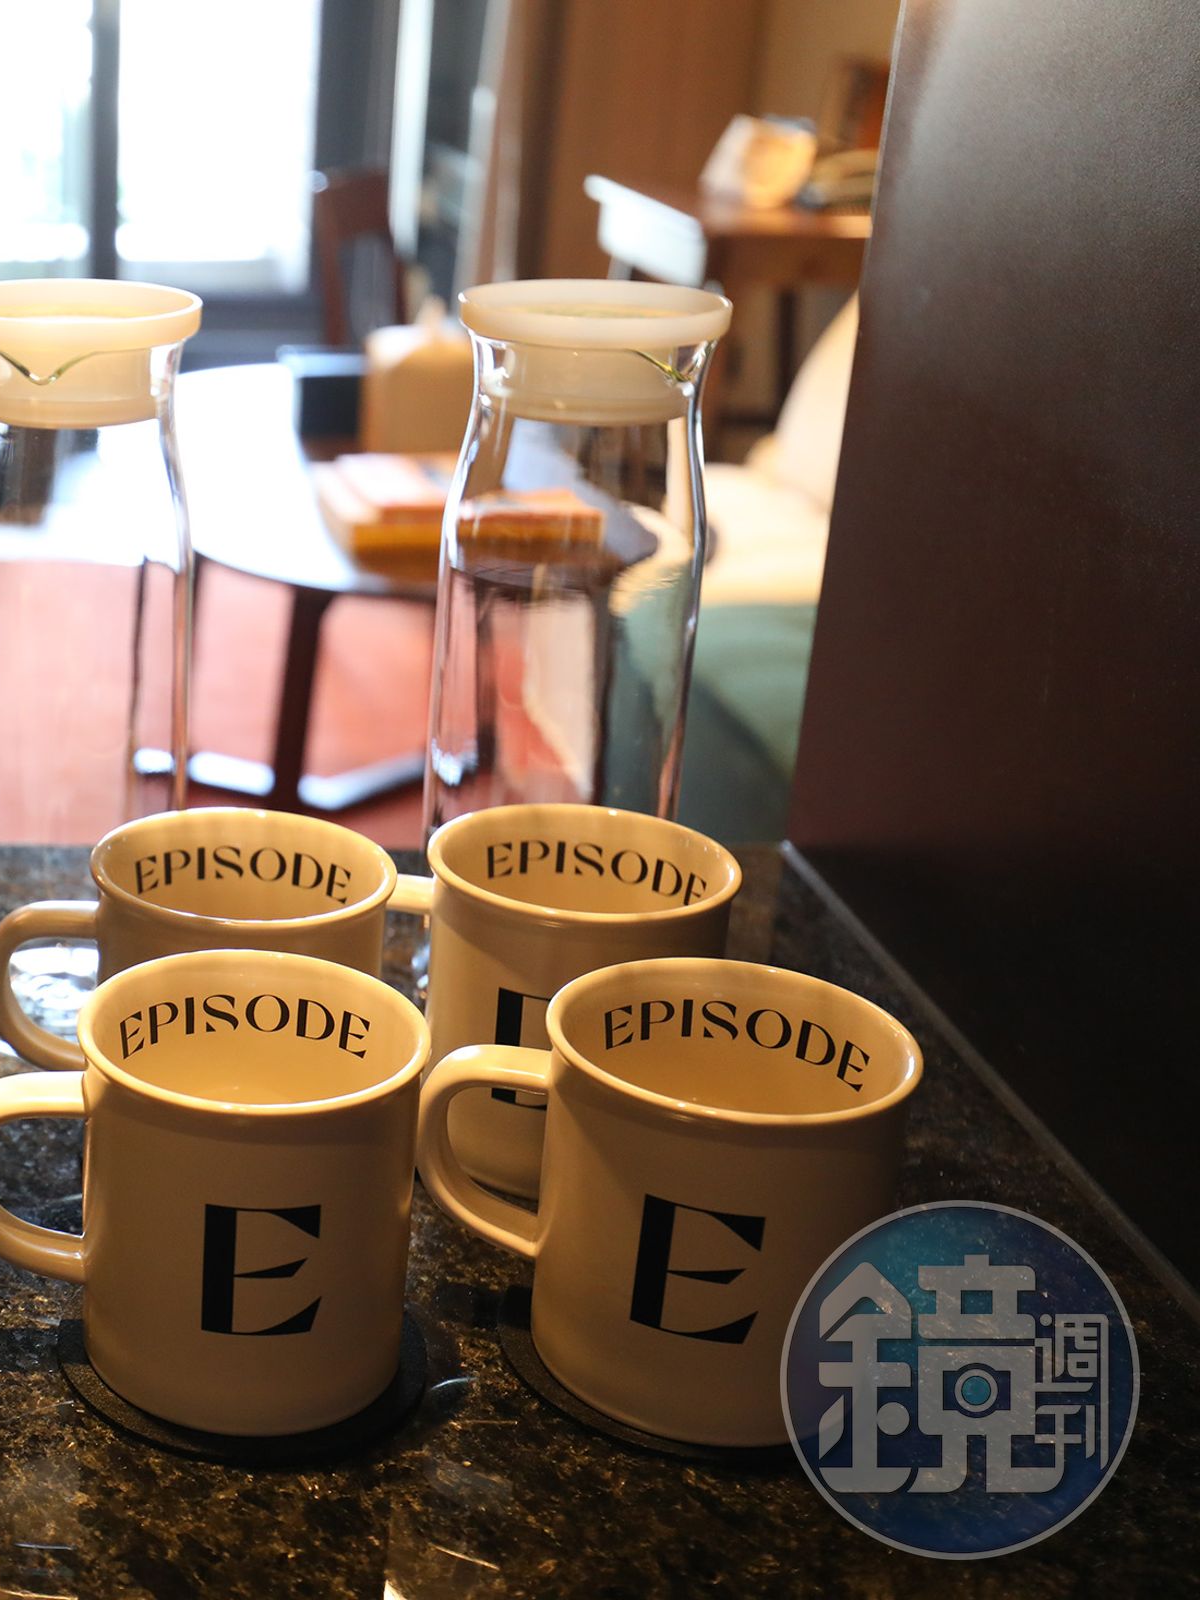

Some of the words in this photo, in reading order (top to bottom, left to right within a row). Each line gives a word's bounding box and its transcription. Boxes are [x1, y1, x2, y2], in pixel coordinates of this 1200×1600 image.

[135, 846, 351, 904] EPISODE
[119, 994, 370, 1059] EPISODE
[604, 999, 870, 1092] EPISODE
[201, 1204, 322, 1336] E
[630, 1194, 766, 1345] E
